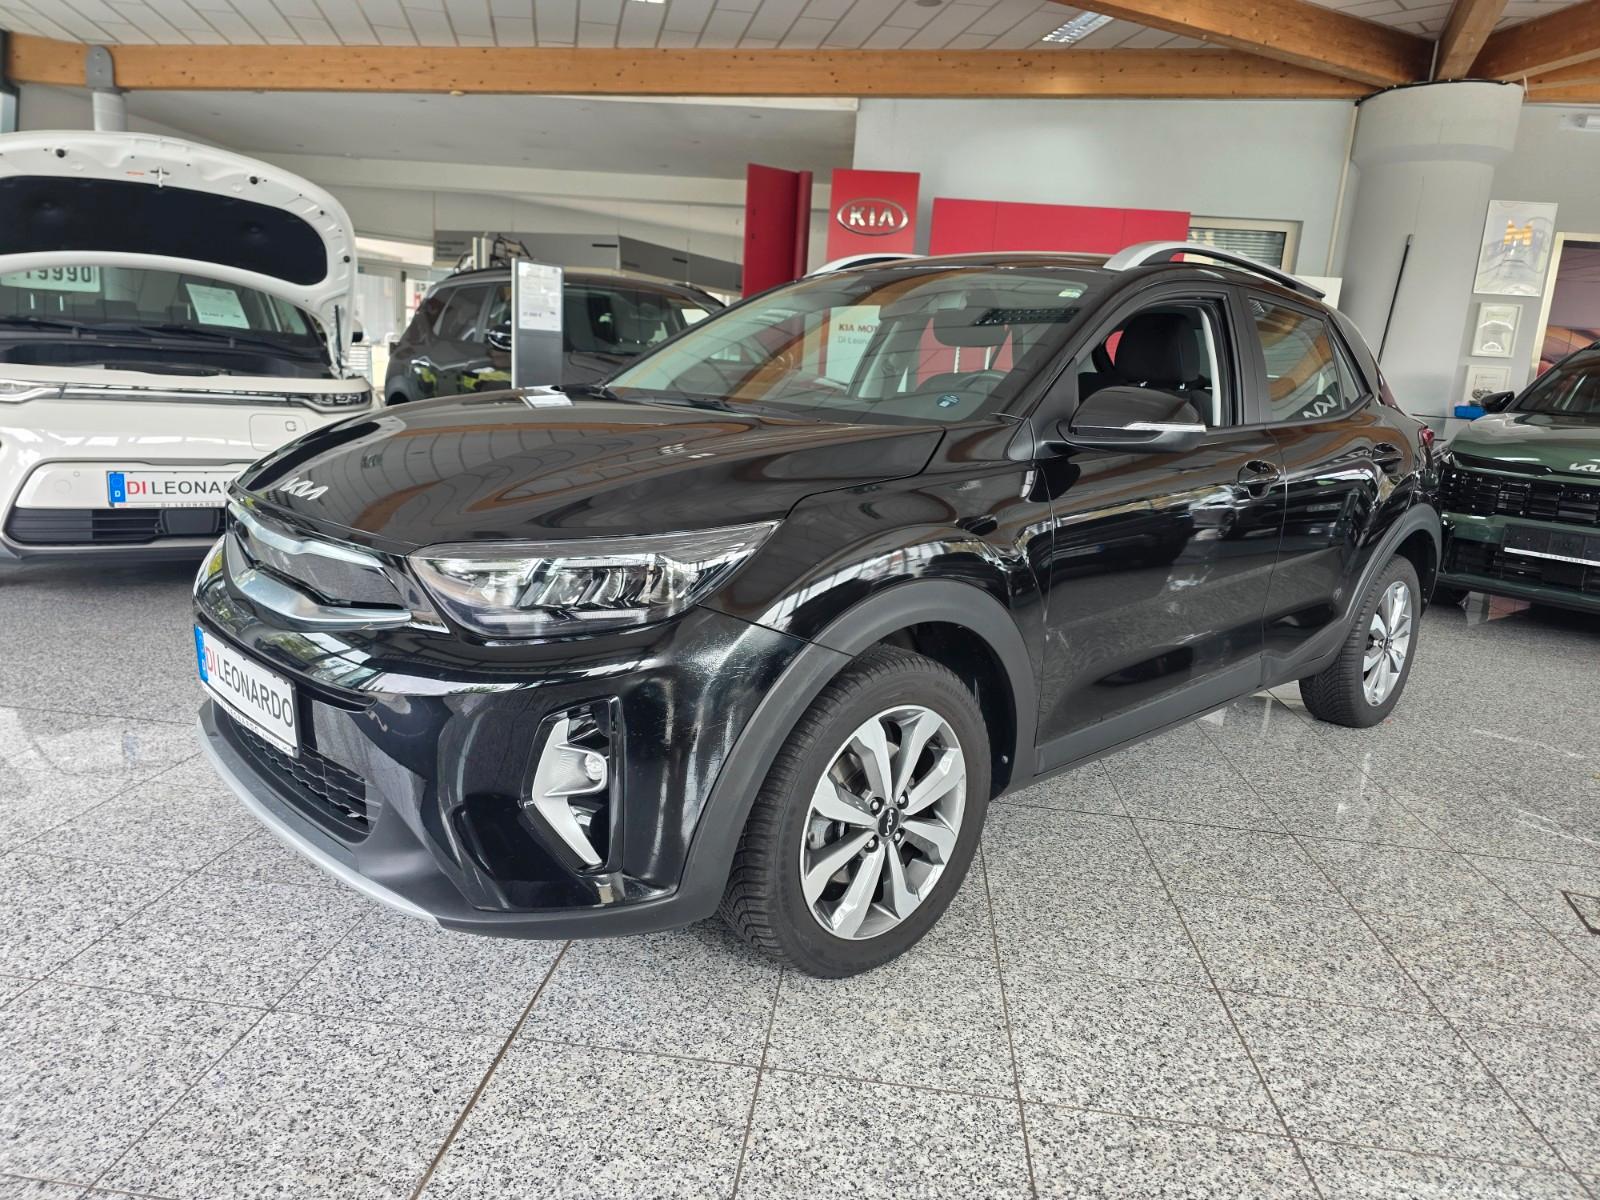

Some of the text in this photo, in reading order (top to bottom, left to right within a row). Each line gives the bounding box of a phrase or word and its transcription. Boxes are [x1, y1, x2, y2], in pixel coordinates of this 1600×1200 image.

[849, 206, 895, 226] KIA
[127, 481, 146, 495] DI
[280, 477, 329, 500] KIA
[205, 646, 217, 677] DI
[217, 654, 294, 728] LEONARDO
